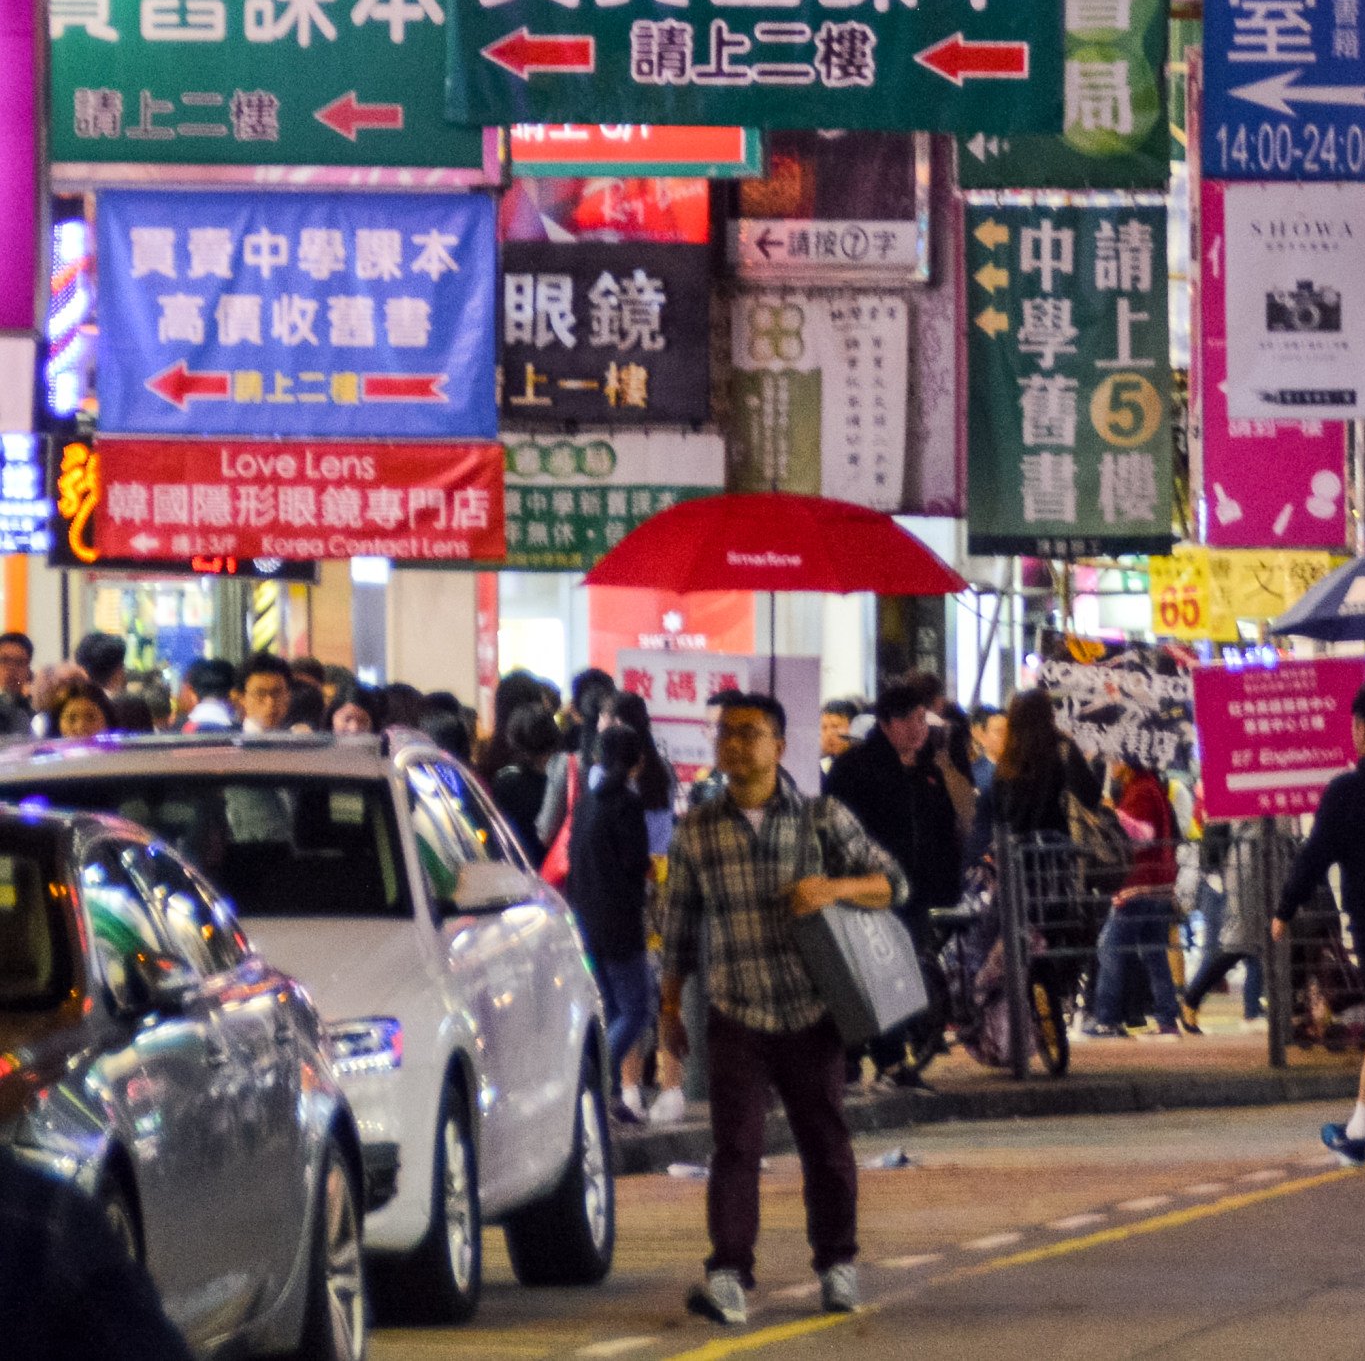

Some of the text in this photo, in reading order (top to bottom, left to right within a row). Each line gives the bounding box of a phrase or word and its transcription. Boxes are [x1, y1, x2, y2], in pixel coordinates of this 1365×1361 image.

[630, 18, 878, 87] 請上二樓
[74, 88, 281, 142] 請上二樓
[129, 225, 460, 282] 買賣中學課本
[156, 292, 433, 349] 高價收舊書
[503, 269, 667, 351] 眼鏡
[232, 370, 361, 406] 請上二樓
[1016, 218, 1080, 525] 中學舊書
[220, 449, 377, 481] Love Lens
[106, 481, 489, 531] 韓國隱形眼鏡專門店
[261, 535, 328, 557] Korea
[419, 537, 470, 560] Lens
[1159, 585, 1201, 629] 65
